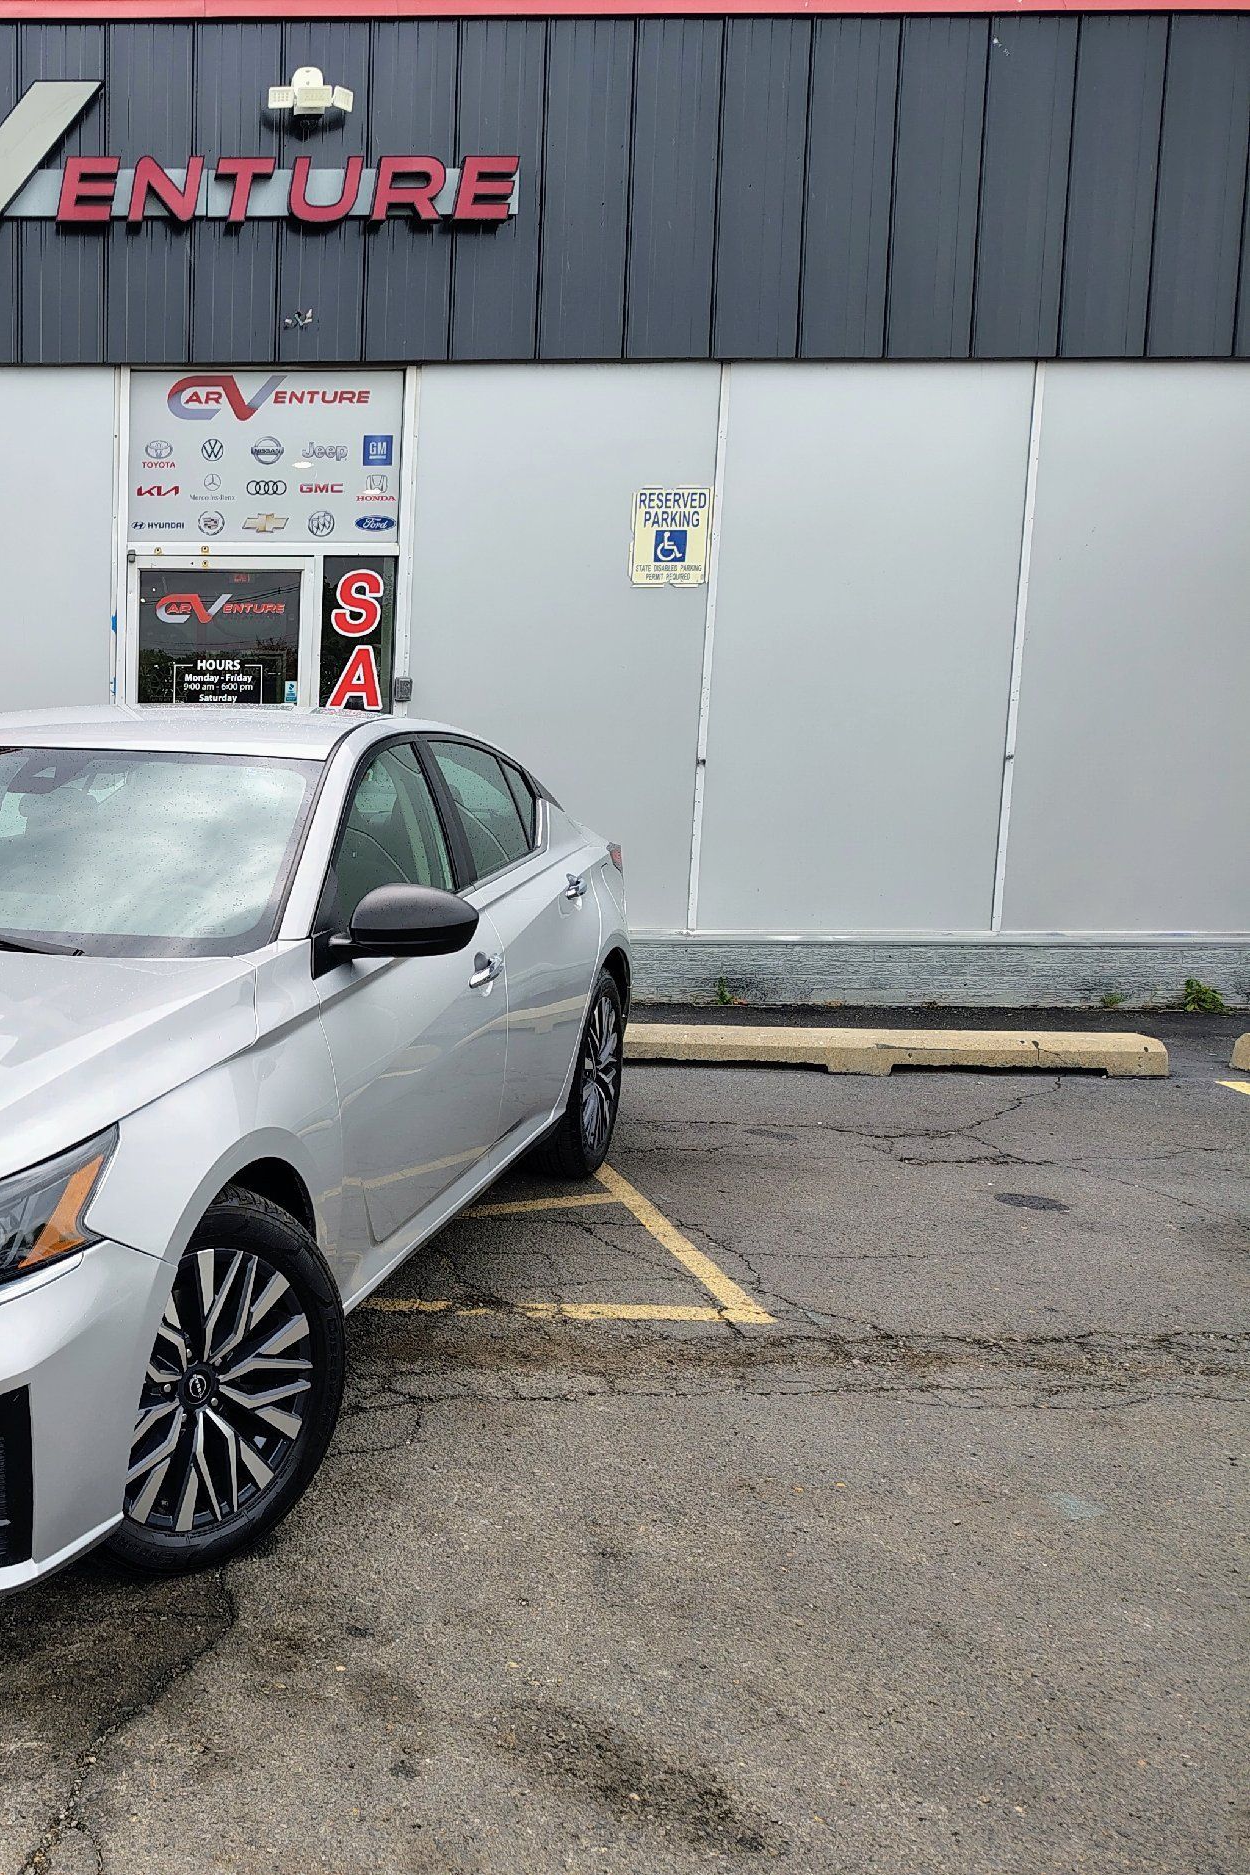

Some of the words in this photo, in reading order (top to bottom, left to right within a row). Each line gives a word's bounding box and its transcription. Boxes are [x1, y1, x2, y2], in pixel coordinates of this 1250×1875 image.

[302, 441, 348, 461] Jeep
[369, 442, 387, 455] GM
[142, 461, 176, 469] TOYOTA
[299, 483, 344, 493] GMC
[639, 492, 707, 509] RESERVED
[362, 518, 388, 529] Ford
[643, 511, 700, 528] PARKING
[147, 521, 184, 529] HYUNDAI
[635, 564, 652, 572] STATE
[653, 564, 678, 572] DISABLED
[679, 564, 702, 572] PARKING
[645, 573, 664, 581] PERMIT
[666, 573, 691, 581] REQUIRED
[196, 659, 241, 671] HOURS
[184, 673, 219, 683] Monday
[225, 673, 253, 683] Friday
[183, 683, 200, 691] 9:00
[221, 683, 238, 691] 6:00
[239, 684, 254, 692] pm
[198, 694, 238, 703] Saturday
